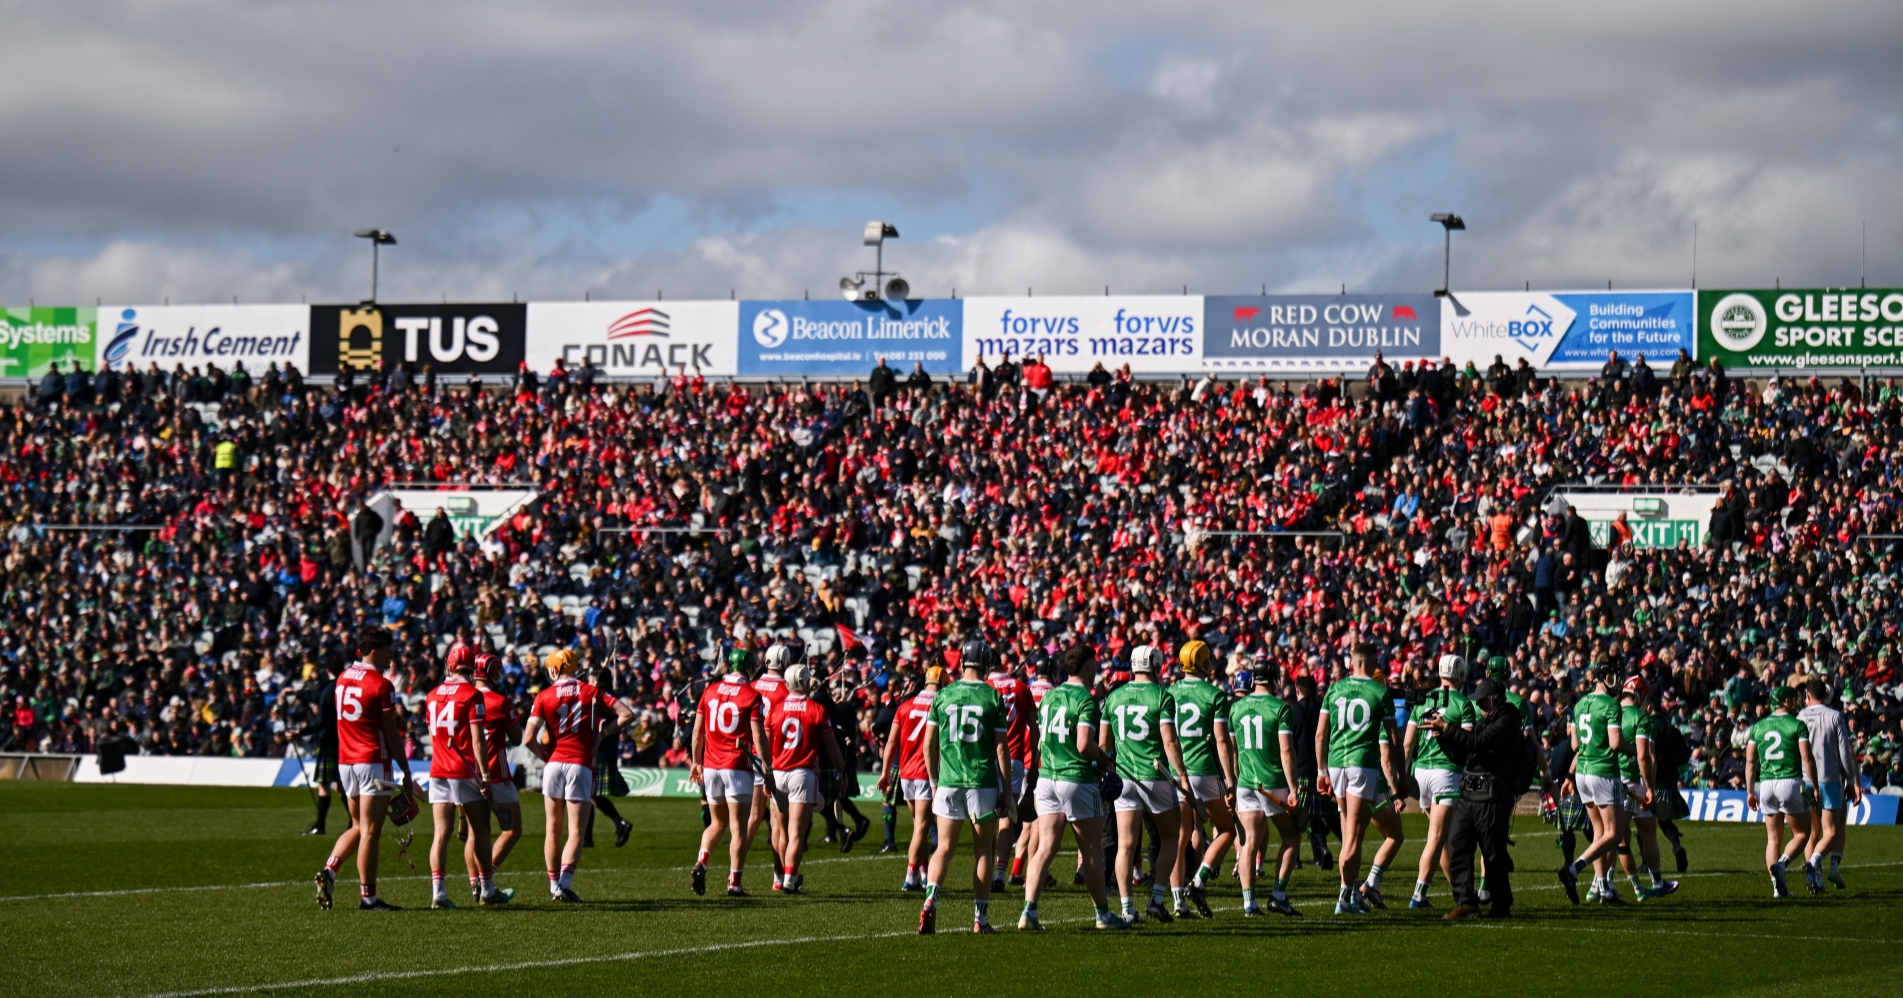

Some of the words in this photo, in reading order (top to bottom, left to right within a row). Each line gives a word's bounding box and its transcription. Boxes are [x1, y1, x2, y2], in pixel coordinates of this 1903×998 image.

[1000, 309, 1079, 335] forvis
[1114, 309, 1194, 335] forvis
[1270, 305, 1317, 325] RED
[1323, 304, 1383, 325] COW
[1590, 303, 1644, 317] Building
[1775, 294, 1903, 323] GLEESO
[0, 321, 91, 349] Systems
[792, 317, 862, 340] Beacon
[866, 316, 951, 340] Limerick
[1230, 328, 1320, 348] MORAN
[1328, 327, 1421, 348] DUBLIN
[1589, 331, 1608, 344] for
[1611, 331, 1633, 344] the
[1637, 332, 1681, 344] Future
[1590, 317, 1676, 330] Communities
[1775, 326, 1855, 347] SPORT
[142, 327, 199, 356] Irish
[202, 328, 301, 357] Cement
[395, 316, 500, 363] TUS
[975, 337, 1079, 356] mazars
[1089, 337, 1194, 356] mazars
[1564, 347, 1680, 358] www.whitboxgroup.com
[563, 344, 713, 367] CONACK
[759, 352, 861, 362] www.beaconhospital.ie
[907, 352, 924, 361] 233
[926, 352, 946, 361] 000
[449, 518, 485, 541] XIT
[1629, 522, 1671, 545] XIT
[1679, 522, 1696, 544] 11
[335, 685, 362, 722] 15
[557, 700, 582, 733] 11
[707, 698, 739, 735] 10
[1335, 696, 1371, 732] 10
[428, 700, 459, 736] 14
[908, 709, 928, 742] 7
[945, 704, 983, 743] 15
[1040, 704, 1070, 744] 14
[1113, 704, 1150, 741] 13
[1239, 714, 1263, 750] 11
[1578, 713, 1593, 744] 5
[782, 717, 802, 750] 9
[1764, 730, 1785, 760] 2
